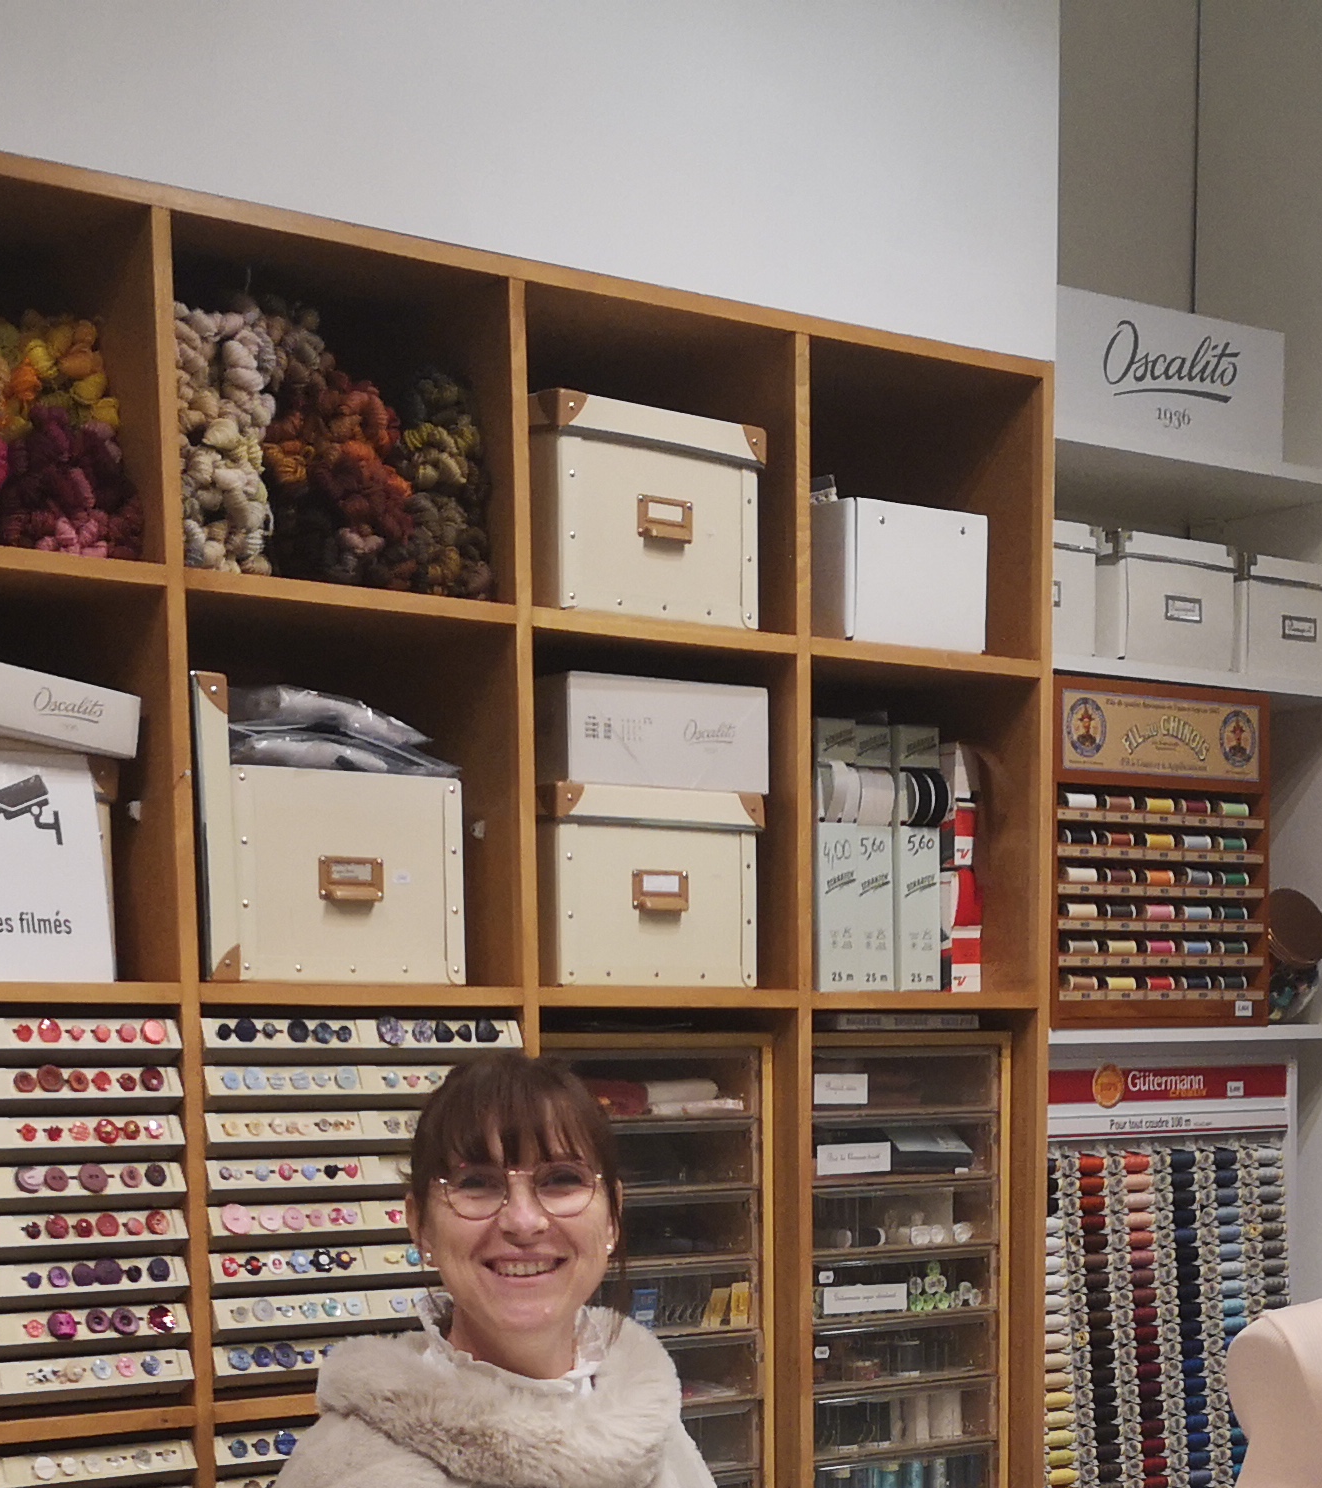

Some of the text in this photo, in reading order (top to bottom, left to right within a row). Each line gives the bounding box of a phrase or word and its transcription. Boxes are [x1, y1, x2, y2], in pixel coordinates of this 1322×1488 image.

[1103, 320, 1240, 388] Oscalito
[1121, 723, 1144, 756] FIL
[1160, 714, 1210, 762] CHINOIS
[907, 834, 935, 856] 5,60
[18, 909, 73, 936] filmés
[1127, 1070, 1204, 1092] Gütermann
[1109, 1119, 1127, 1130] Pour
